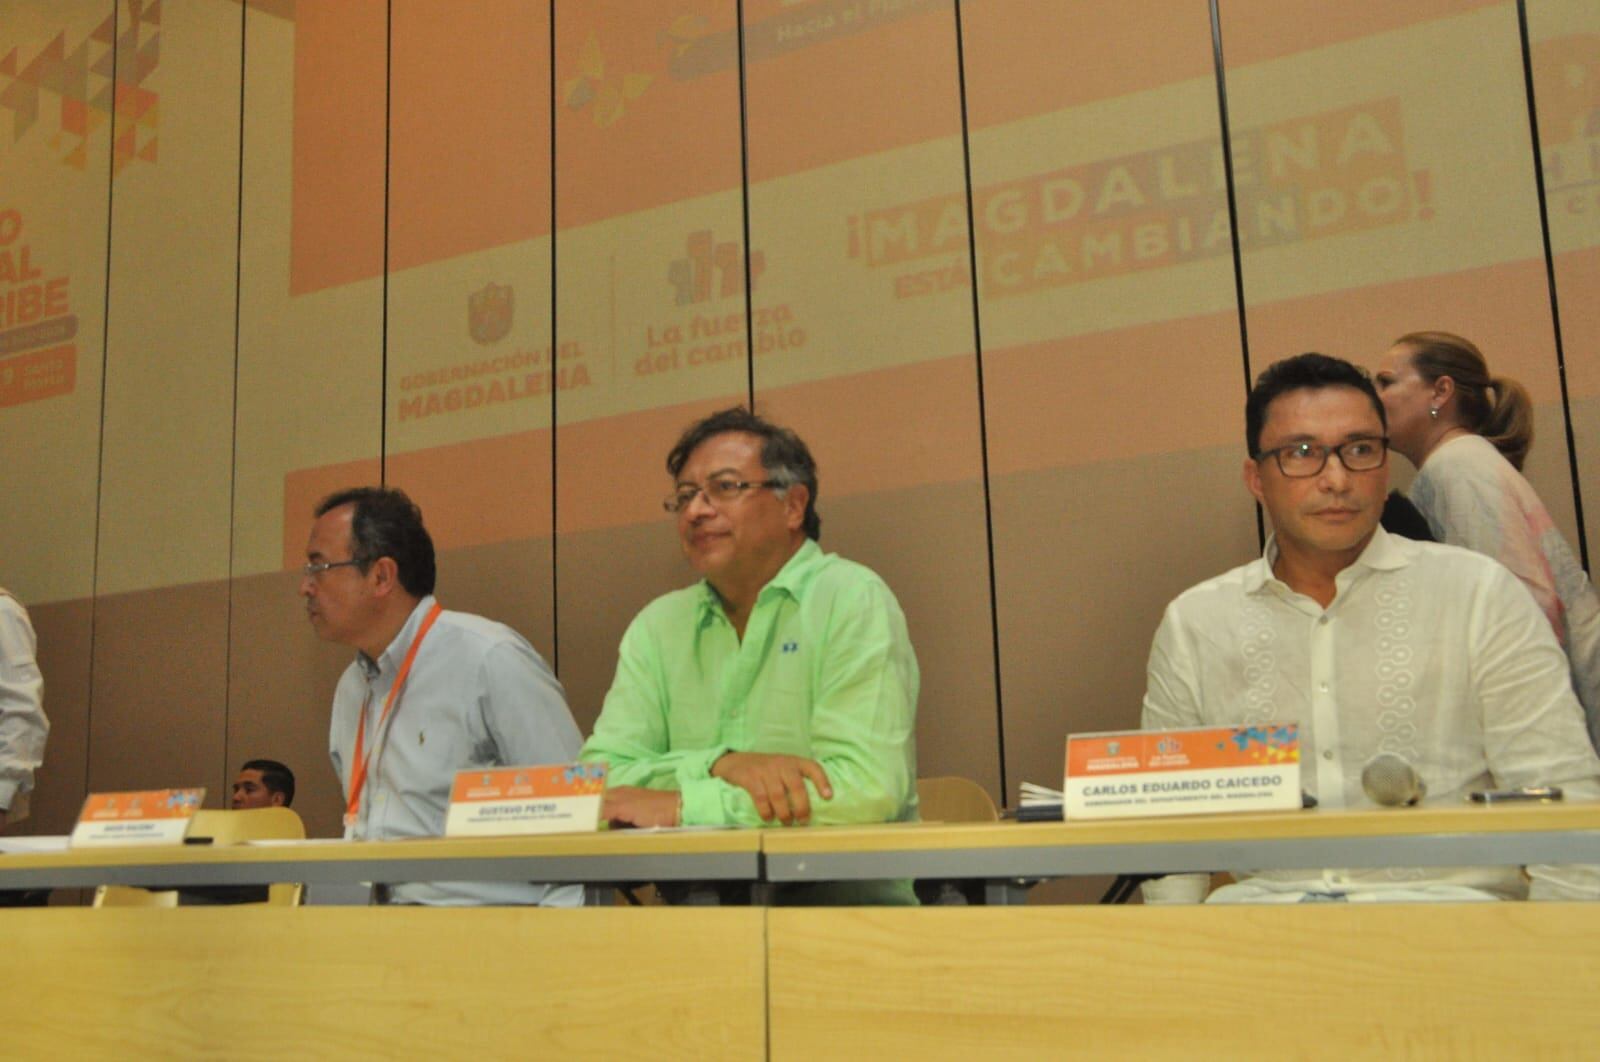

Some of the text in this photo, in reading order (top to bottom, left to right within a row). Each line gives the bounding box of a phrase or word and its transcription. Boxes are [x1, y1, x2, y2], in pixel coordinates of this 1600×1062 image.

[0, 276, 70, 327] IBE
[645, 303, 794, 348] La fueza
[633, 348, 682, 376] del
[399, 363, 592, 422] MAGDALENA
[1082, 774, 1283, 797] CARLOS EDUARDO CAICEDO
[478, 802, 557, 816] GUSTAVO PETRO
